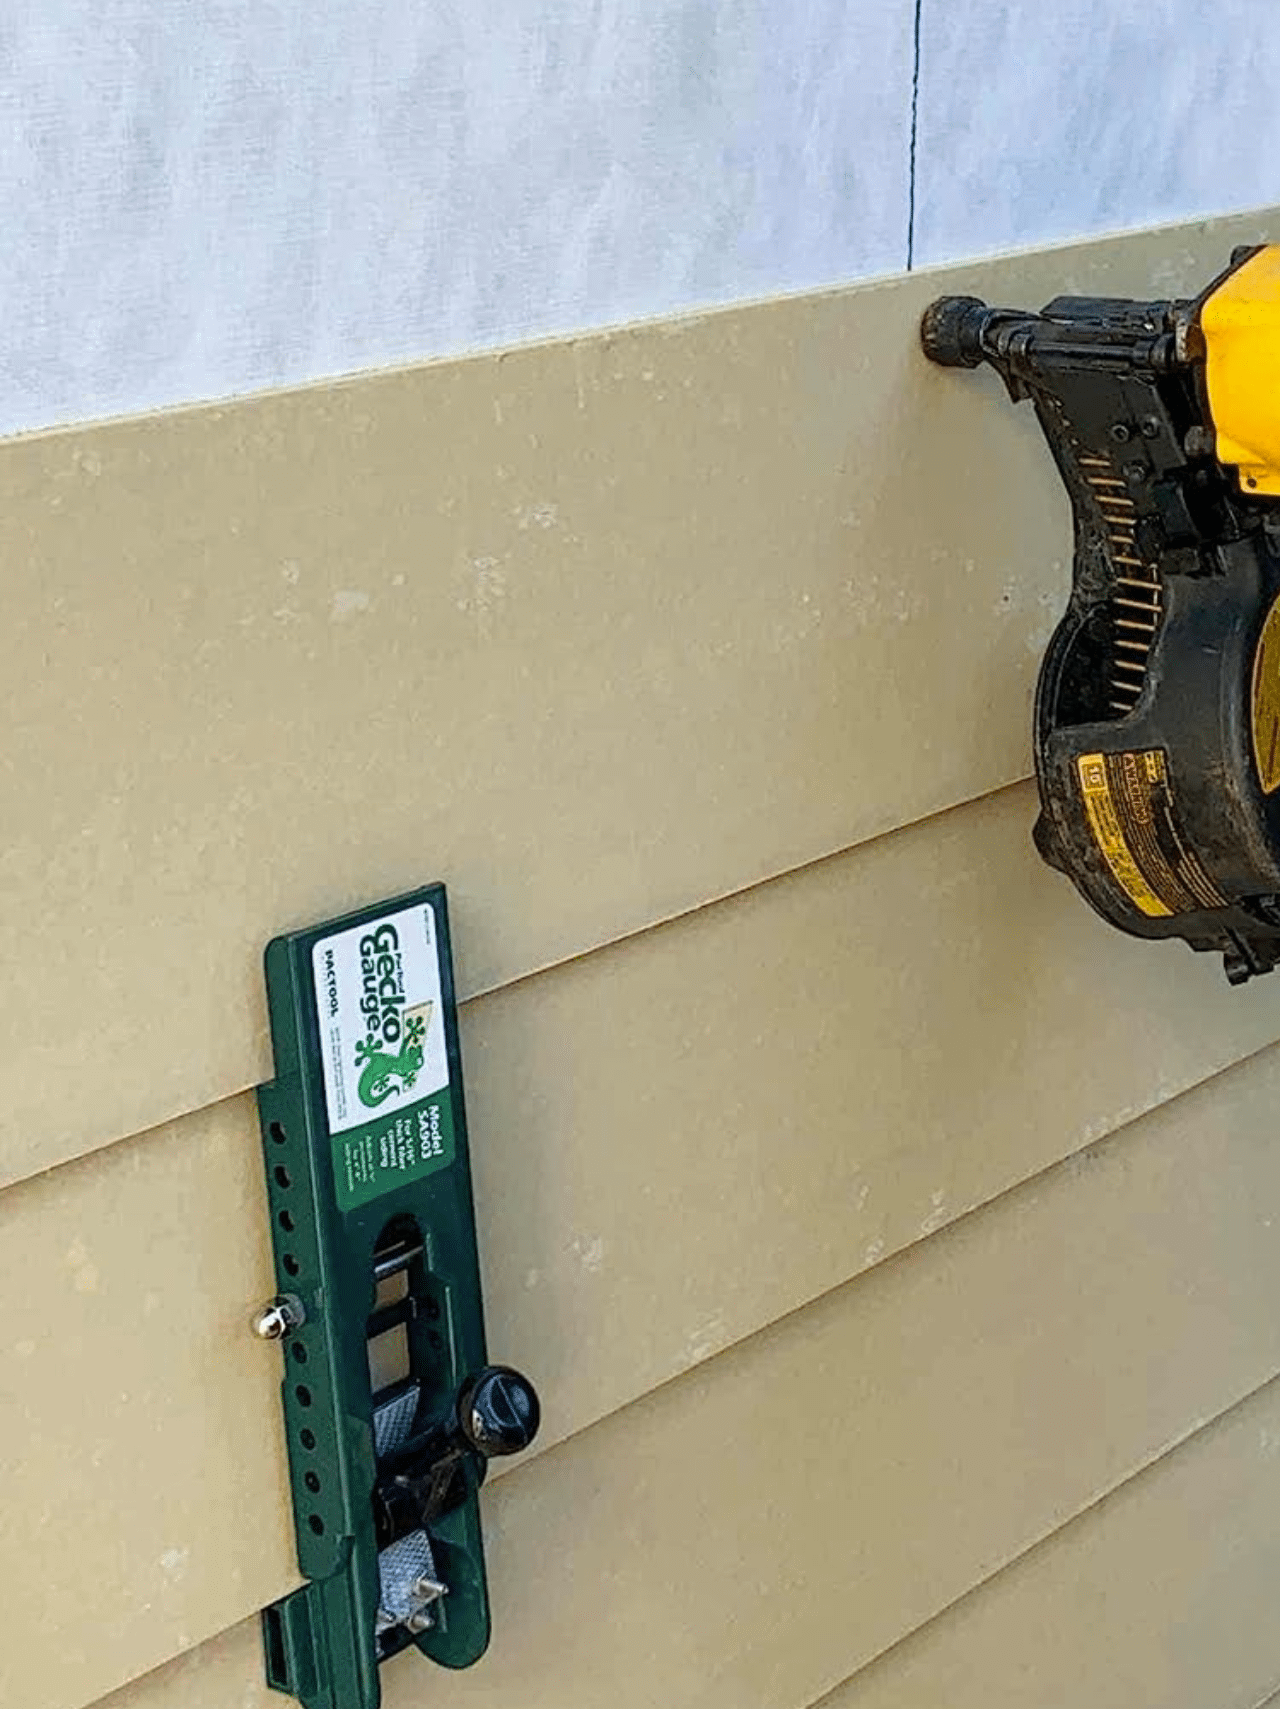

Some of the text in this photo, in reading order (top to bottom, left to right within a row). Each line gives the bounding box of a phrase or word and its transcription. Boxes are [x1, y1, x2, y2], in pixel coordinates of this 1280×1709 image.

[325, 949, 339, 1018] PACTOOL
[360, 934, 381, 1031] Gauge
[374, 923, 406, 1043] Gecko
[417, 1110, 432, 1159] SA903
[428, 1105, 444, 1155] Model
